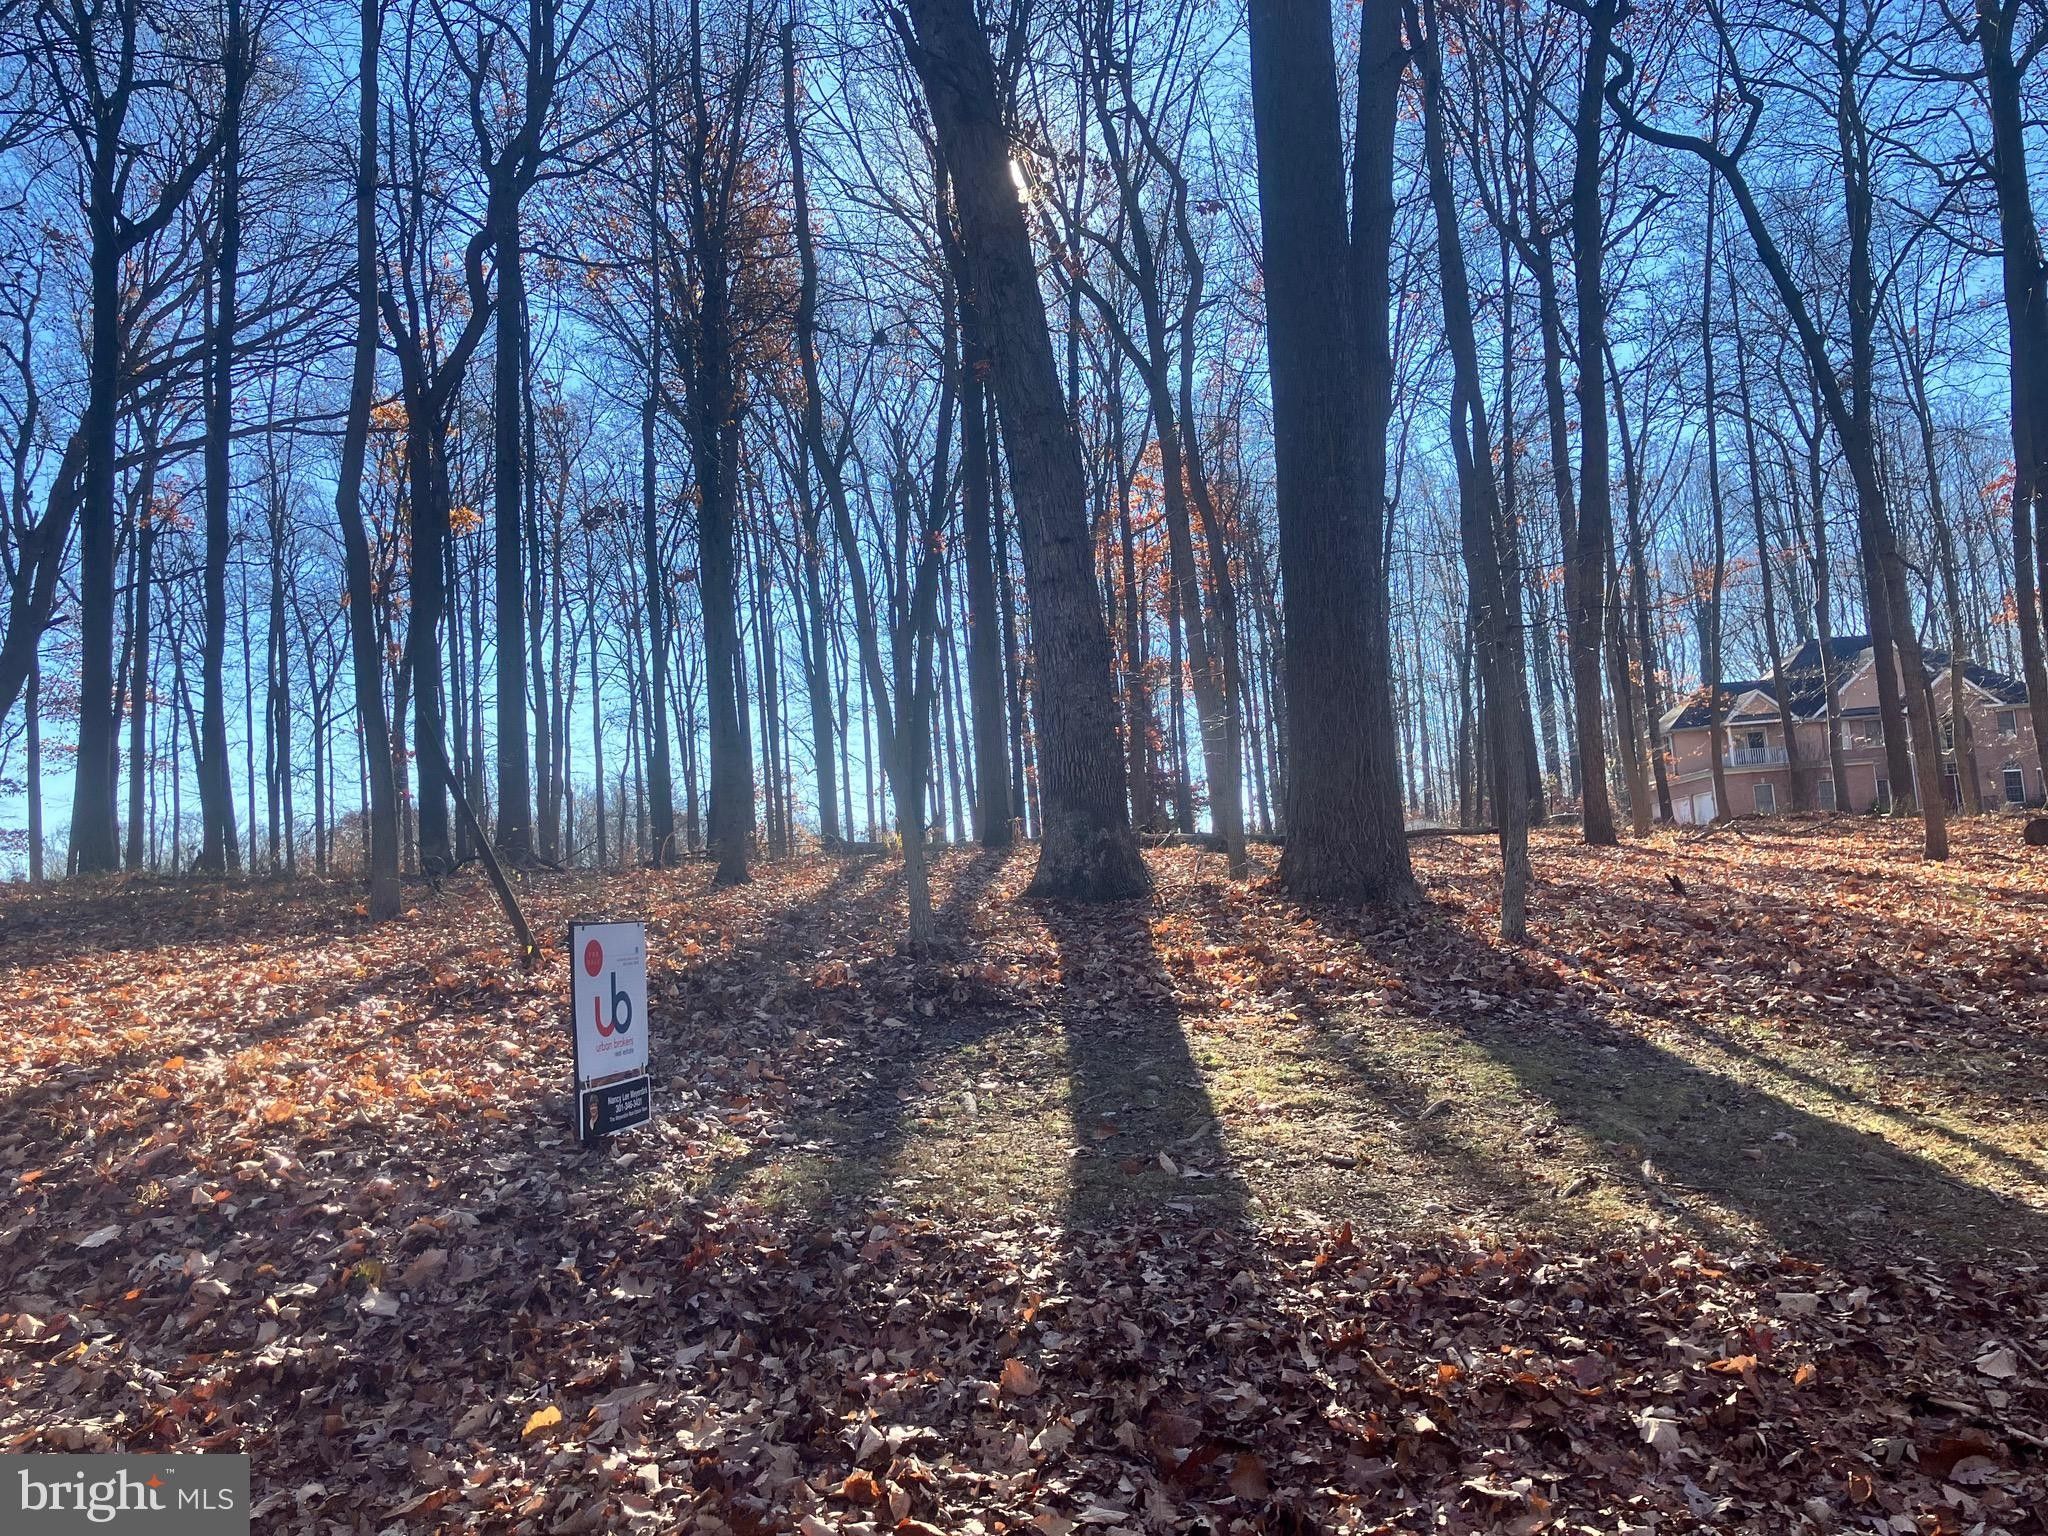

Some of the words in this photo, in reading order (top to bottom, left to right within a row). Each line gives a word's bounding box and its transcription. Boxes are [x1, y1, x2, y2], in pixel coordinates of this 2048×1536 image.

[595, 972, 632, 1037] ub
[596, 1040, 612, 1052] urban
[614, 1037, 633, 1049] brokers
